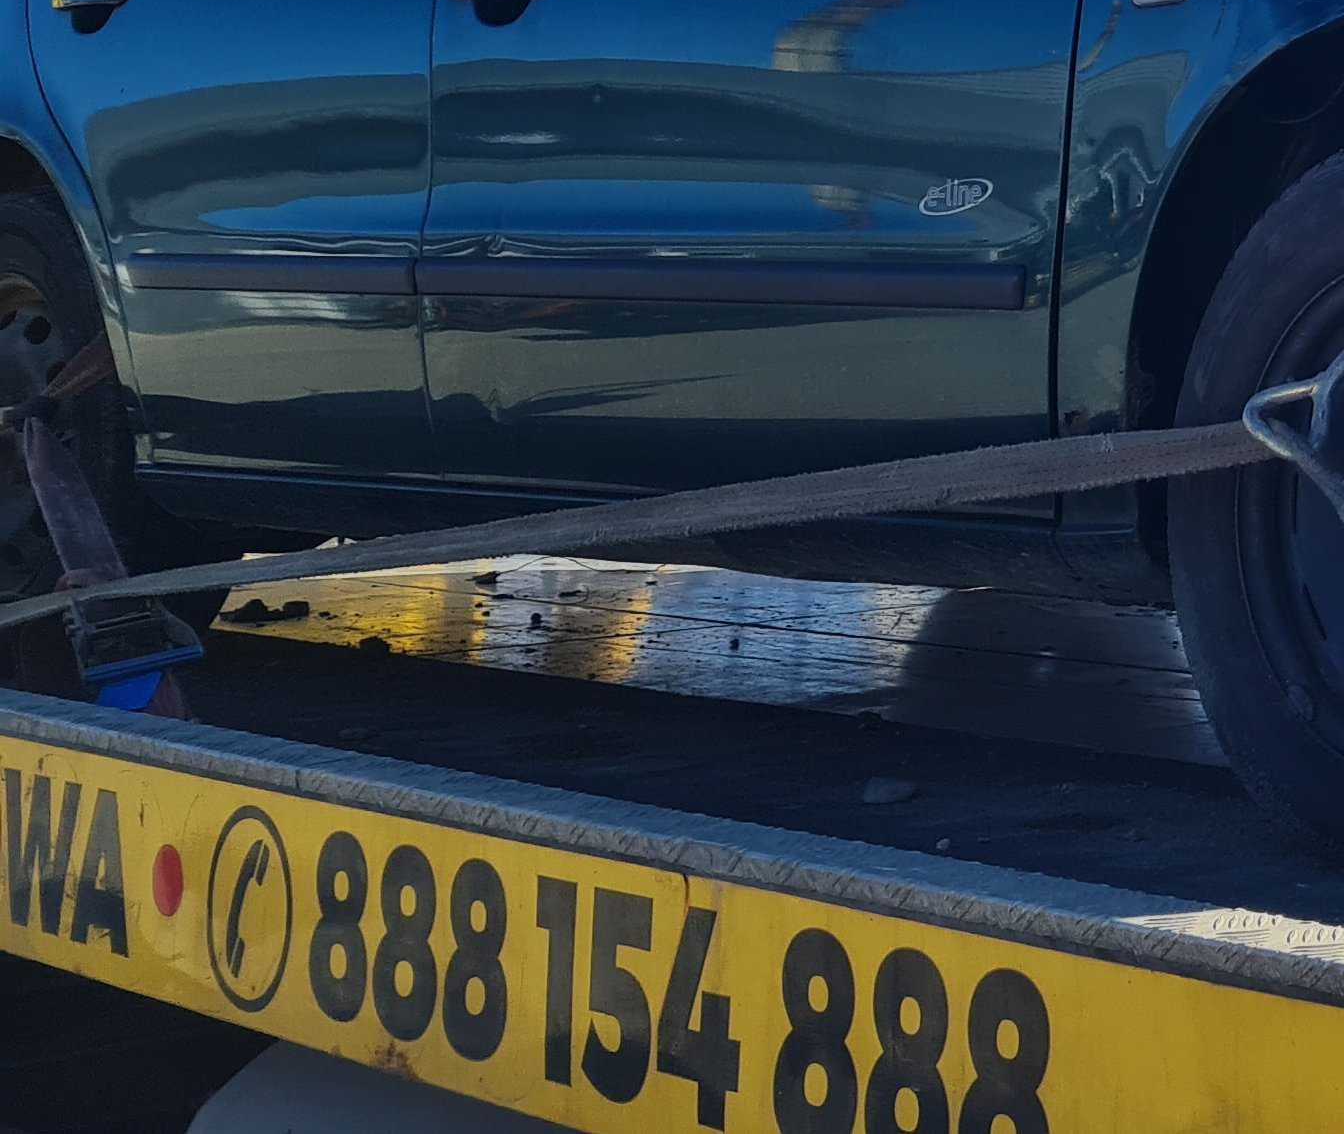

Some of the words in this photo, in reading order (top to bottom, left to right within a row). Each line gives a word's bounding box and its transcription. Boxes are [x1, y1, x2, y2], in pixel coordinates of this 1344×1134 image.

[5, 768, 129, 958] WA
[309, 830, 508, 1062] 888
[535, 874, 741, 1132] 154
[773, 927, 1051, 1134] 888
